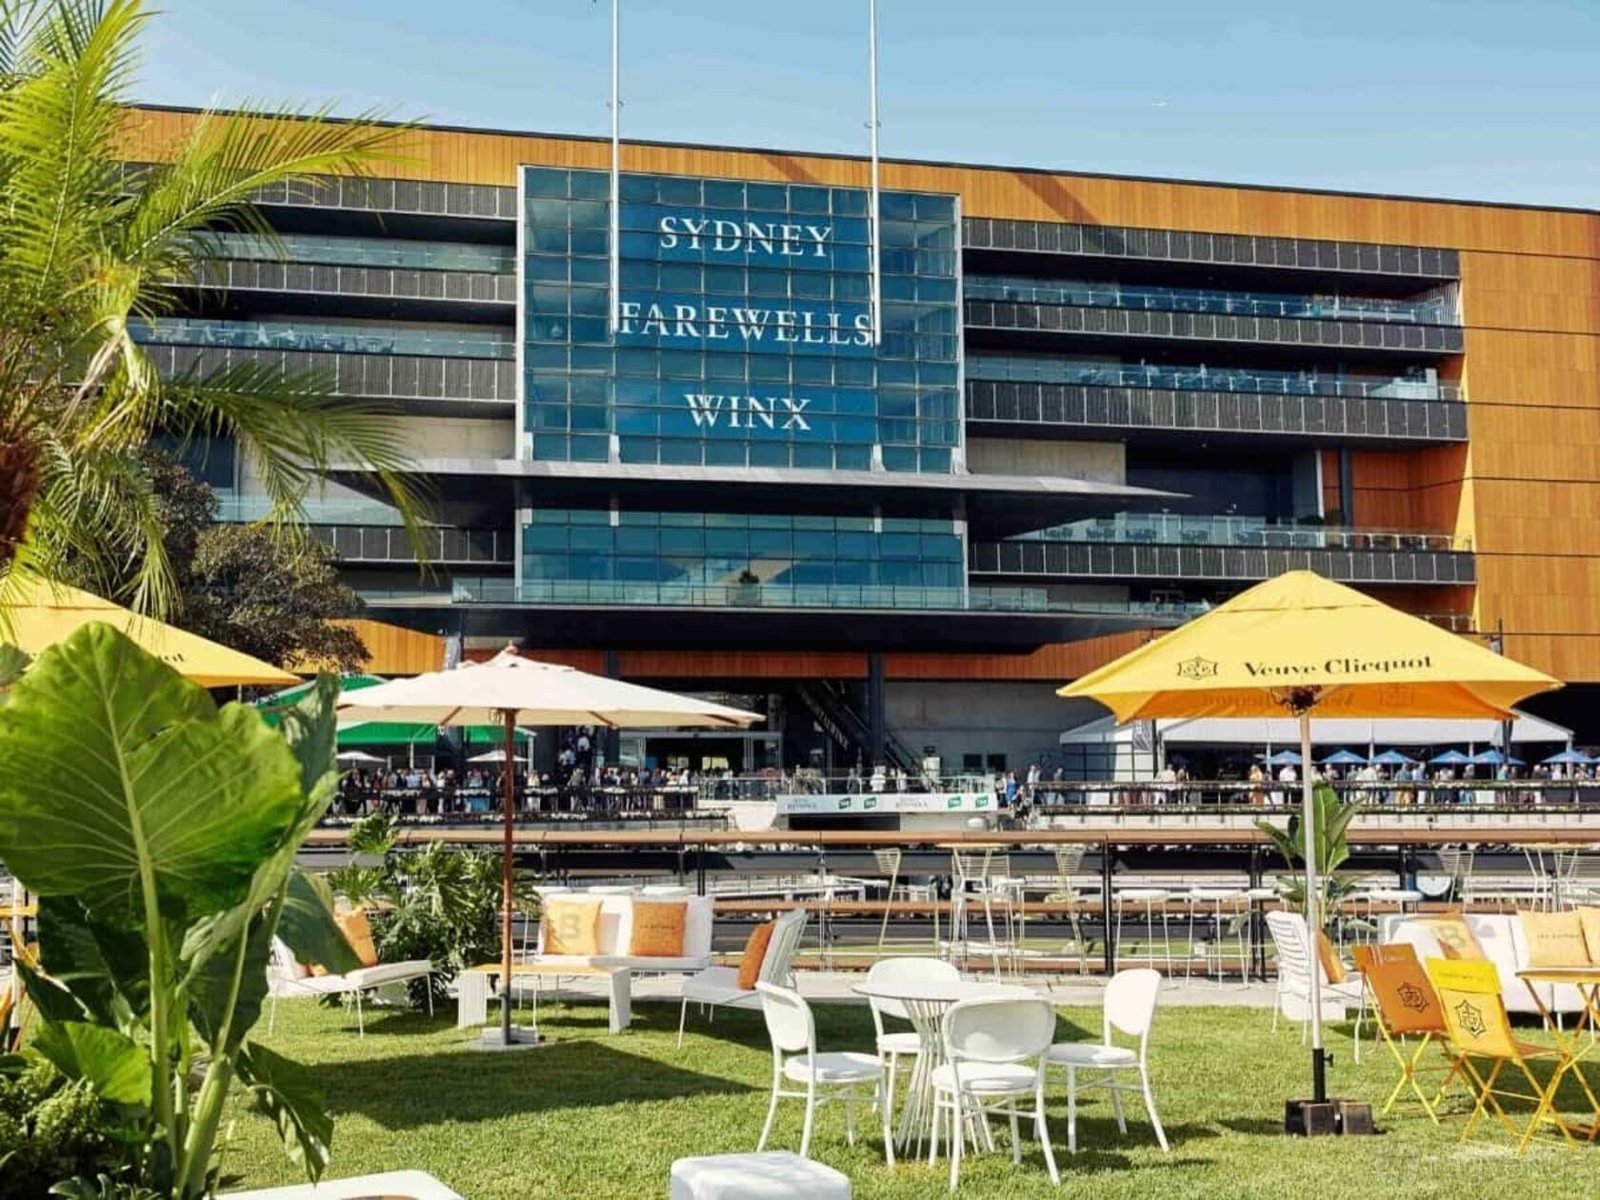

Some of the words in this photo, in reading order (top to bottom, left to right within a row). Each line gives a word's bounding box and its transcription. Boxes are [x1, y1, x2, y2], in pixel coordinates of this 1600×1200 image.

[660, 217, 832, 257] SYDNEY
[619, 302, 871, 346] FAREWELLS
[684, 394, 811, 430] WINX
[1245, 661, 1317, 678] Veuve
[1324, 655, 1431, 674] Clicquot
